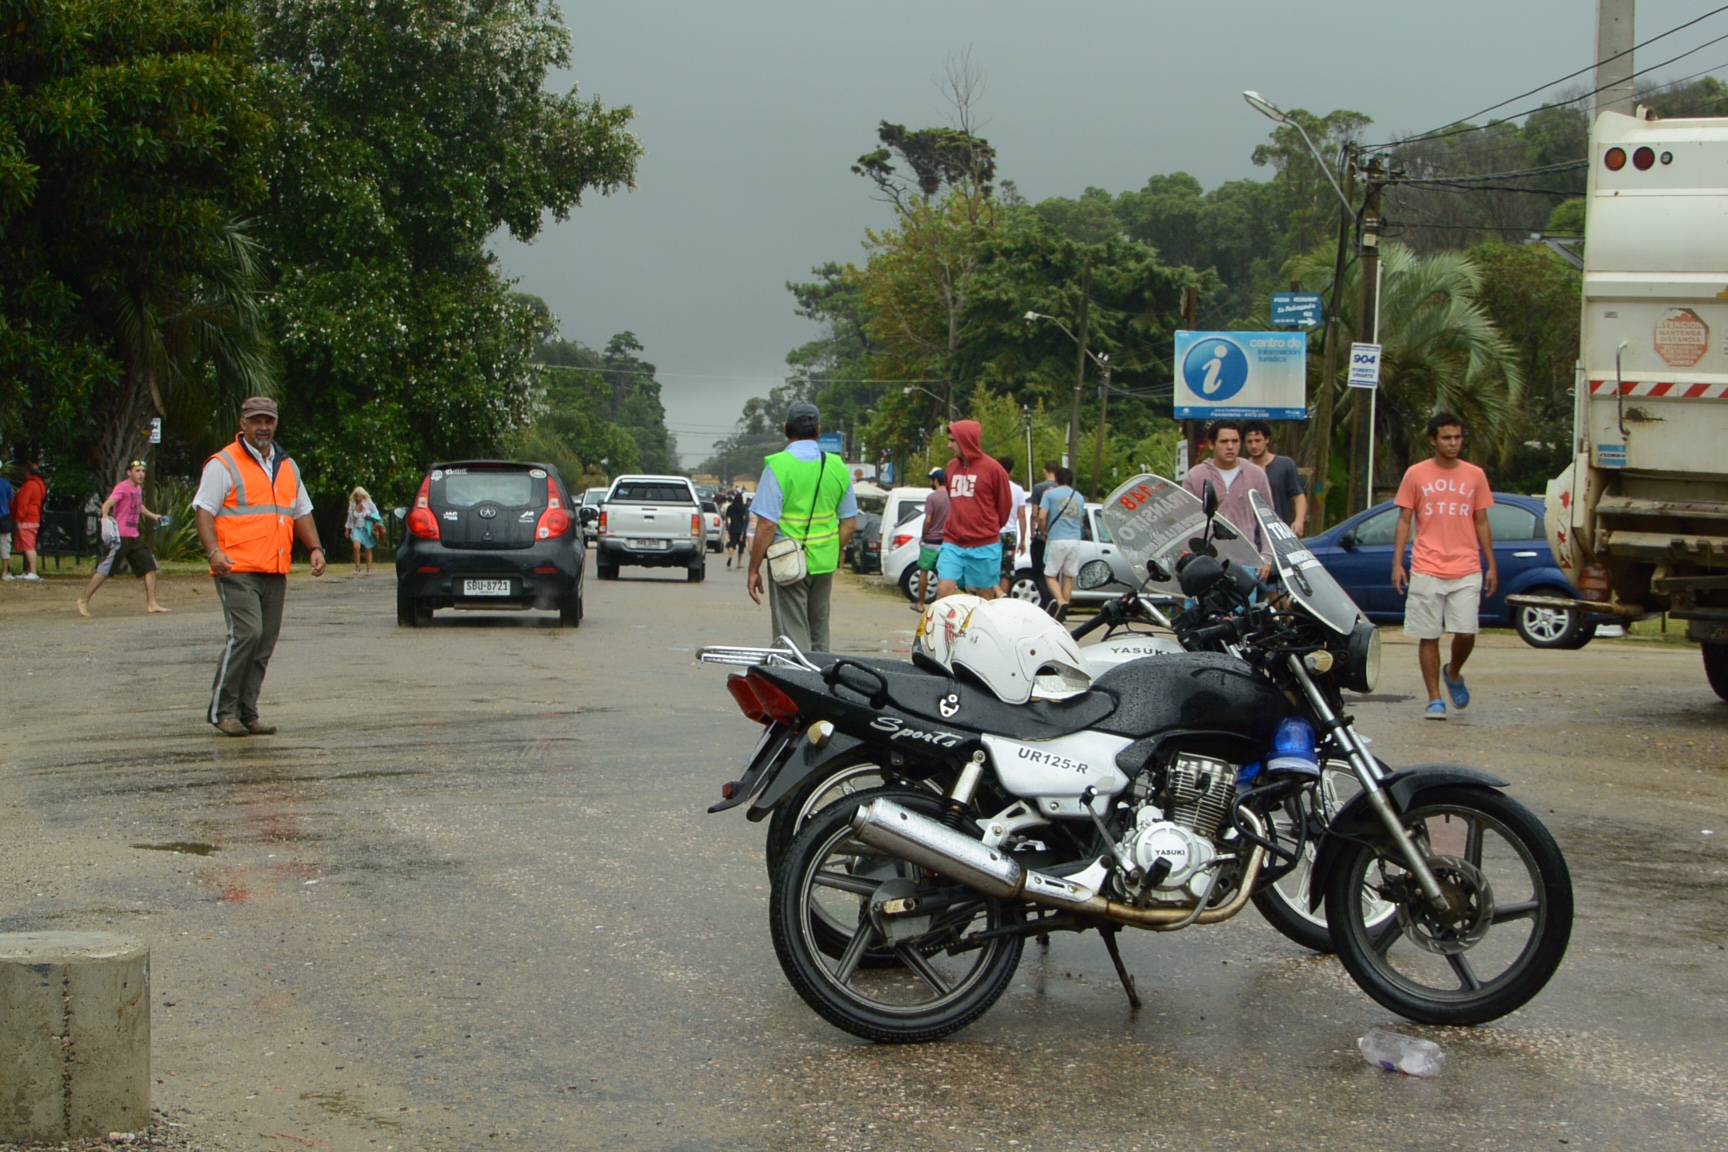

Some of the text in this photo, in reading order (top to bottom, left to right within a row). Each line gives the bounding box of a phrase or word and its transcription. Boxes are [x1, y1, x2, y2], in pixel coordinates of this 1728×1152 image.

[1250, 337, 1302, 348] centro de
[1353, 354, 1376, 364] 904
[1421, 479, 1475, 497] HOLLI
[1424, 502, 1470, 516] STER
[1111, 647, 1171, 656] YASUK
[870, 716, 963, 748] Sports
[1018, 747, 1089, 775] UR125-R
